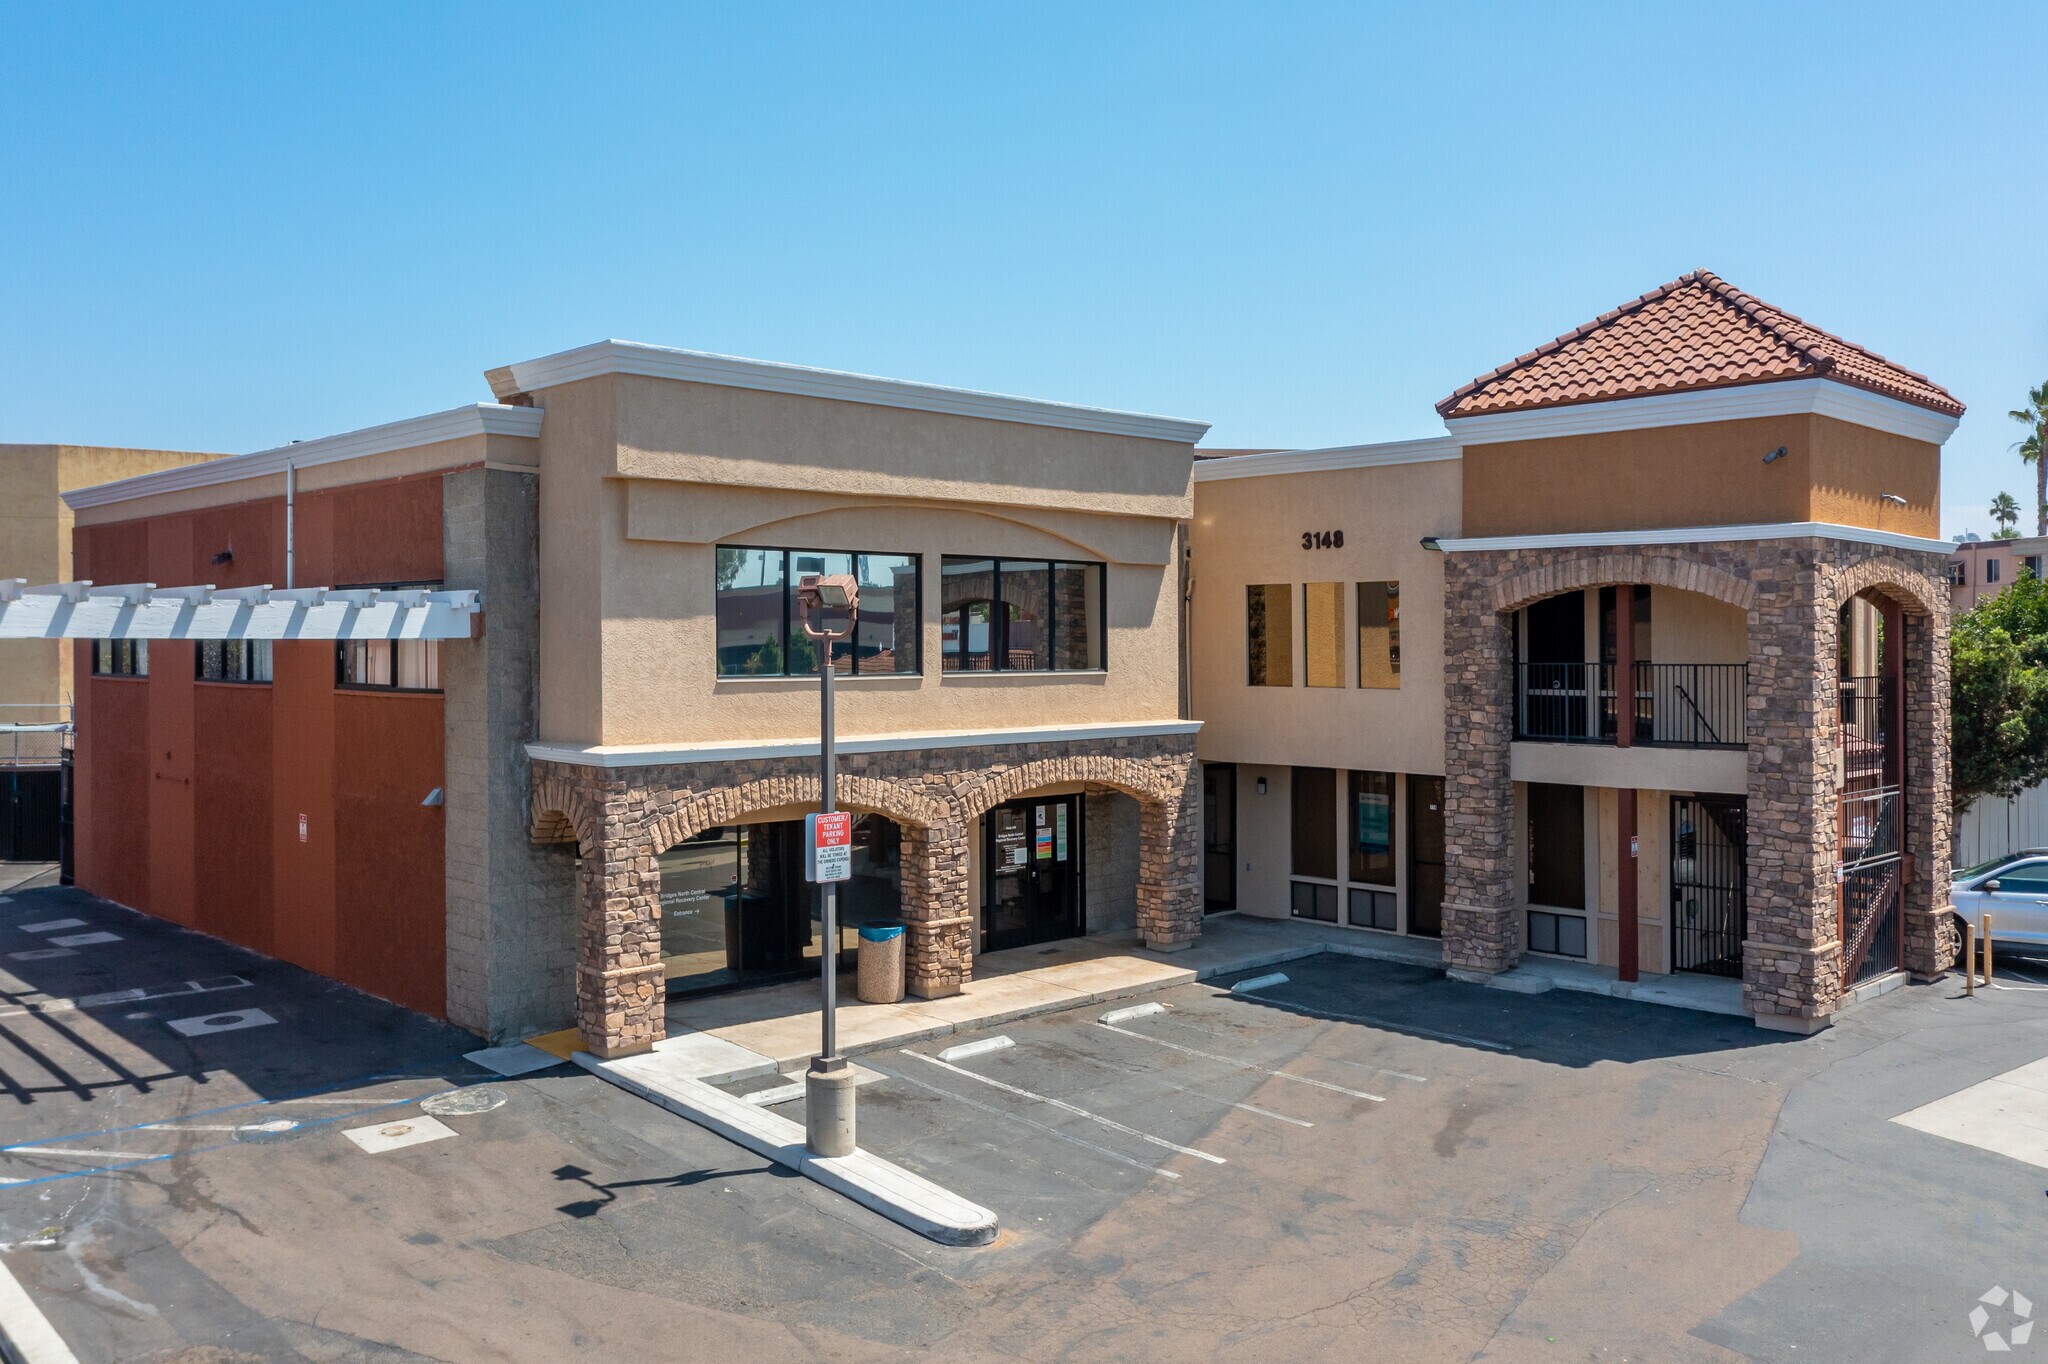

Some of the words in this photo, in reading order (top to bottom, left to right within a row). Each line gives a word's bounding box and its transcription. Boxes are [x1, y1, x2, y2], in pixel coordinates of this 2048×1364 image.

[1302, 530, 1344, 550] 3148
[818, 815, 848, 823] CUSTOMER/
[823, 830, 844, 838] PARKING
